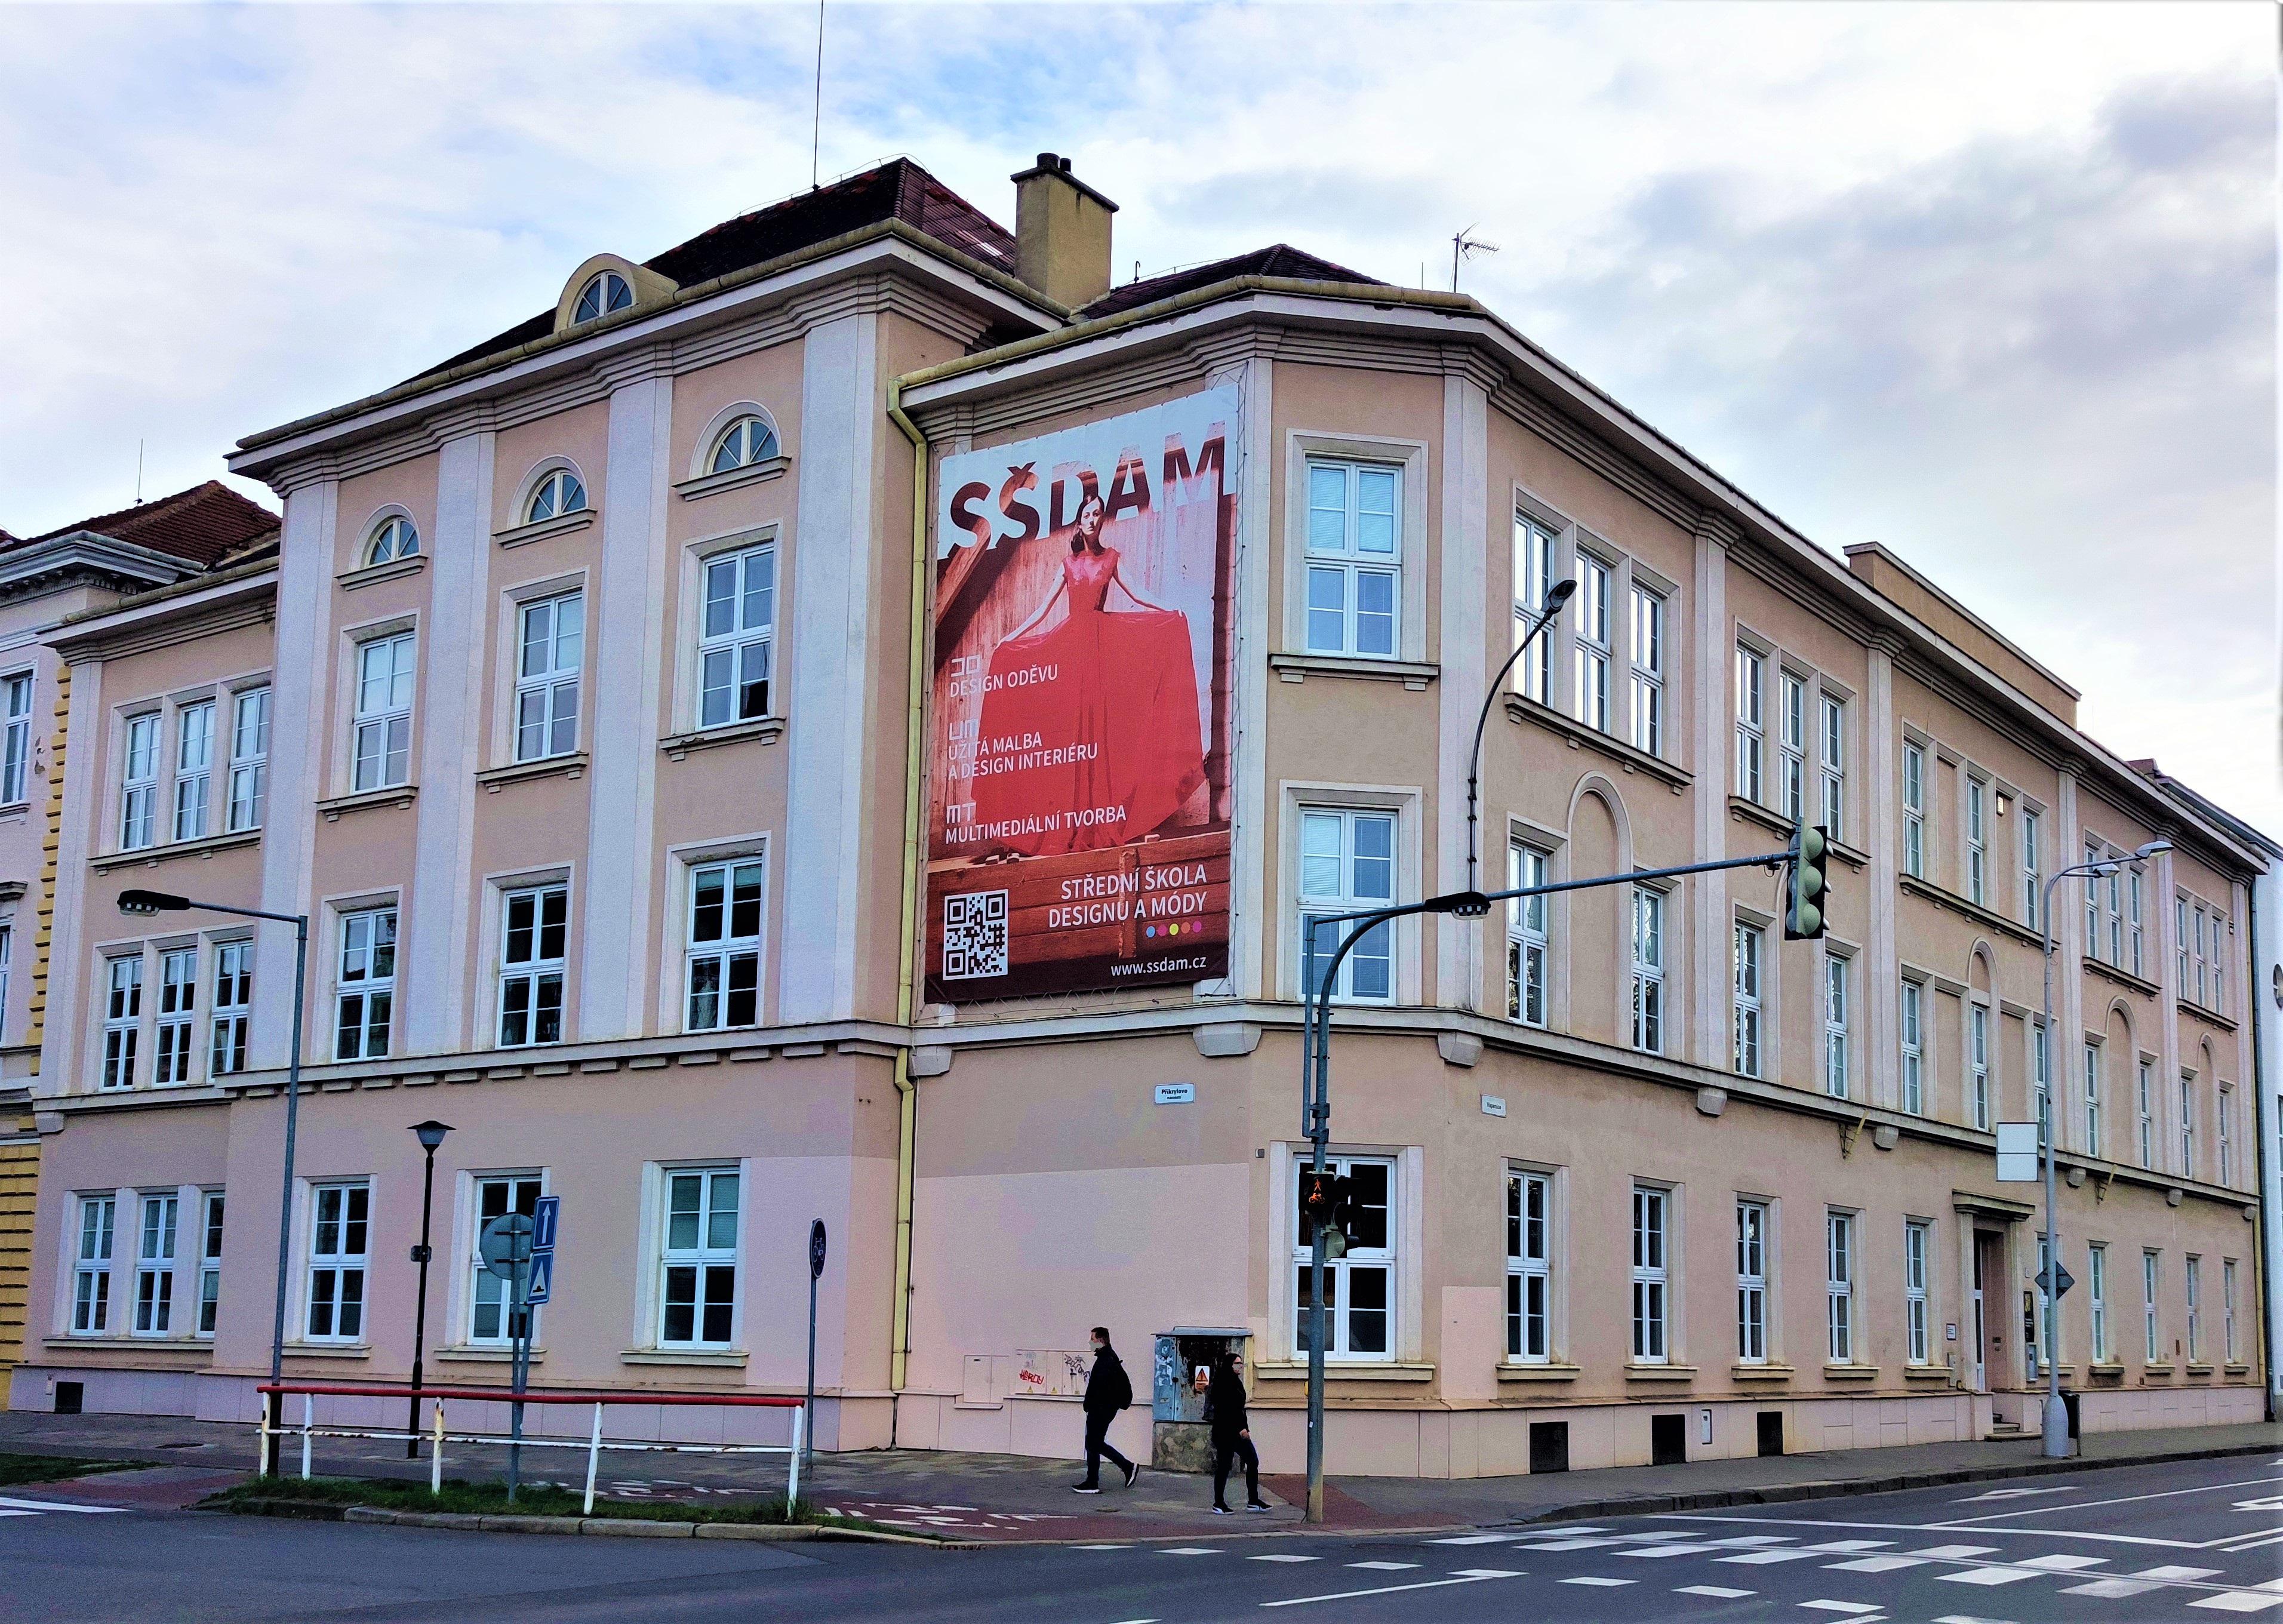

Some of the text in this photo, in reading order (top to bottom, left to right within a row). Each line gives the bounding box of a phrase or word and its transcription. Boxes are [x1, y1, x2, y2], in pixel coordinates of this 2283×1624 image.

[949, 420, 1226, 550] SŠDAM
[950, 664, 1058, 697] DESIGN ODĚVU
[948, 731, 1042, 761] UŽITÁ MALBA
[948, 742, 1098, 780] A DESIGN INTERIÉRU
[946, 805, 1127, 844] MULTIMEDIÁLNÍ TVORBA
[1061, 864, 1207, 900] STŘEDNÍ ŠKOLA
[1049, 891, 1207, 928] DESIGNU A MÓDY
[1110, 956, 1207, 976] www.ssdam.cz
